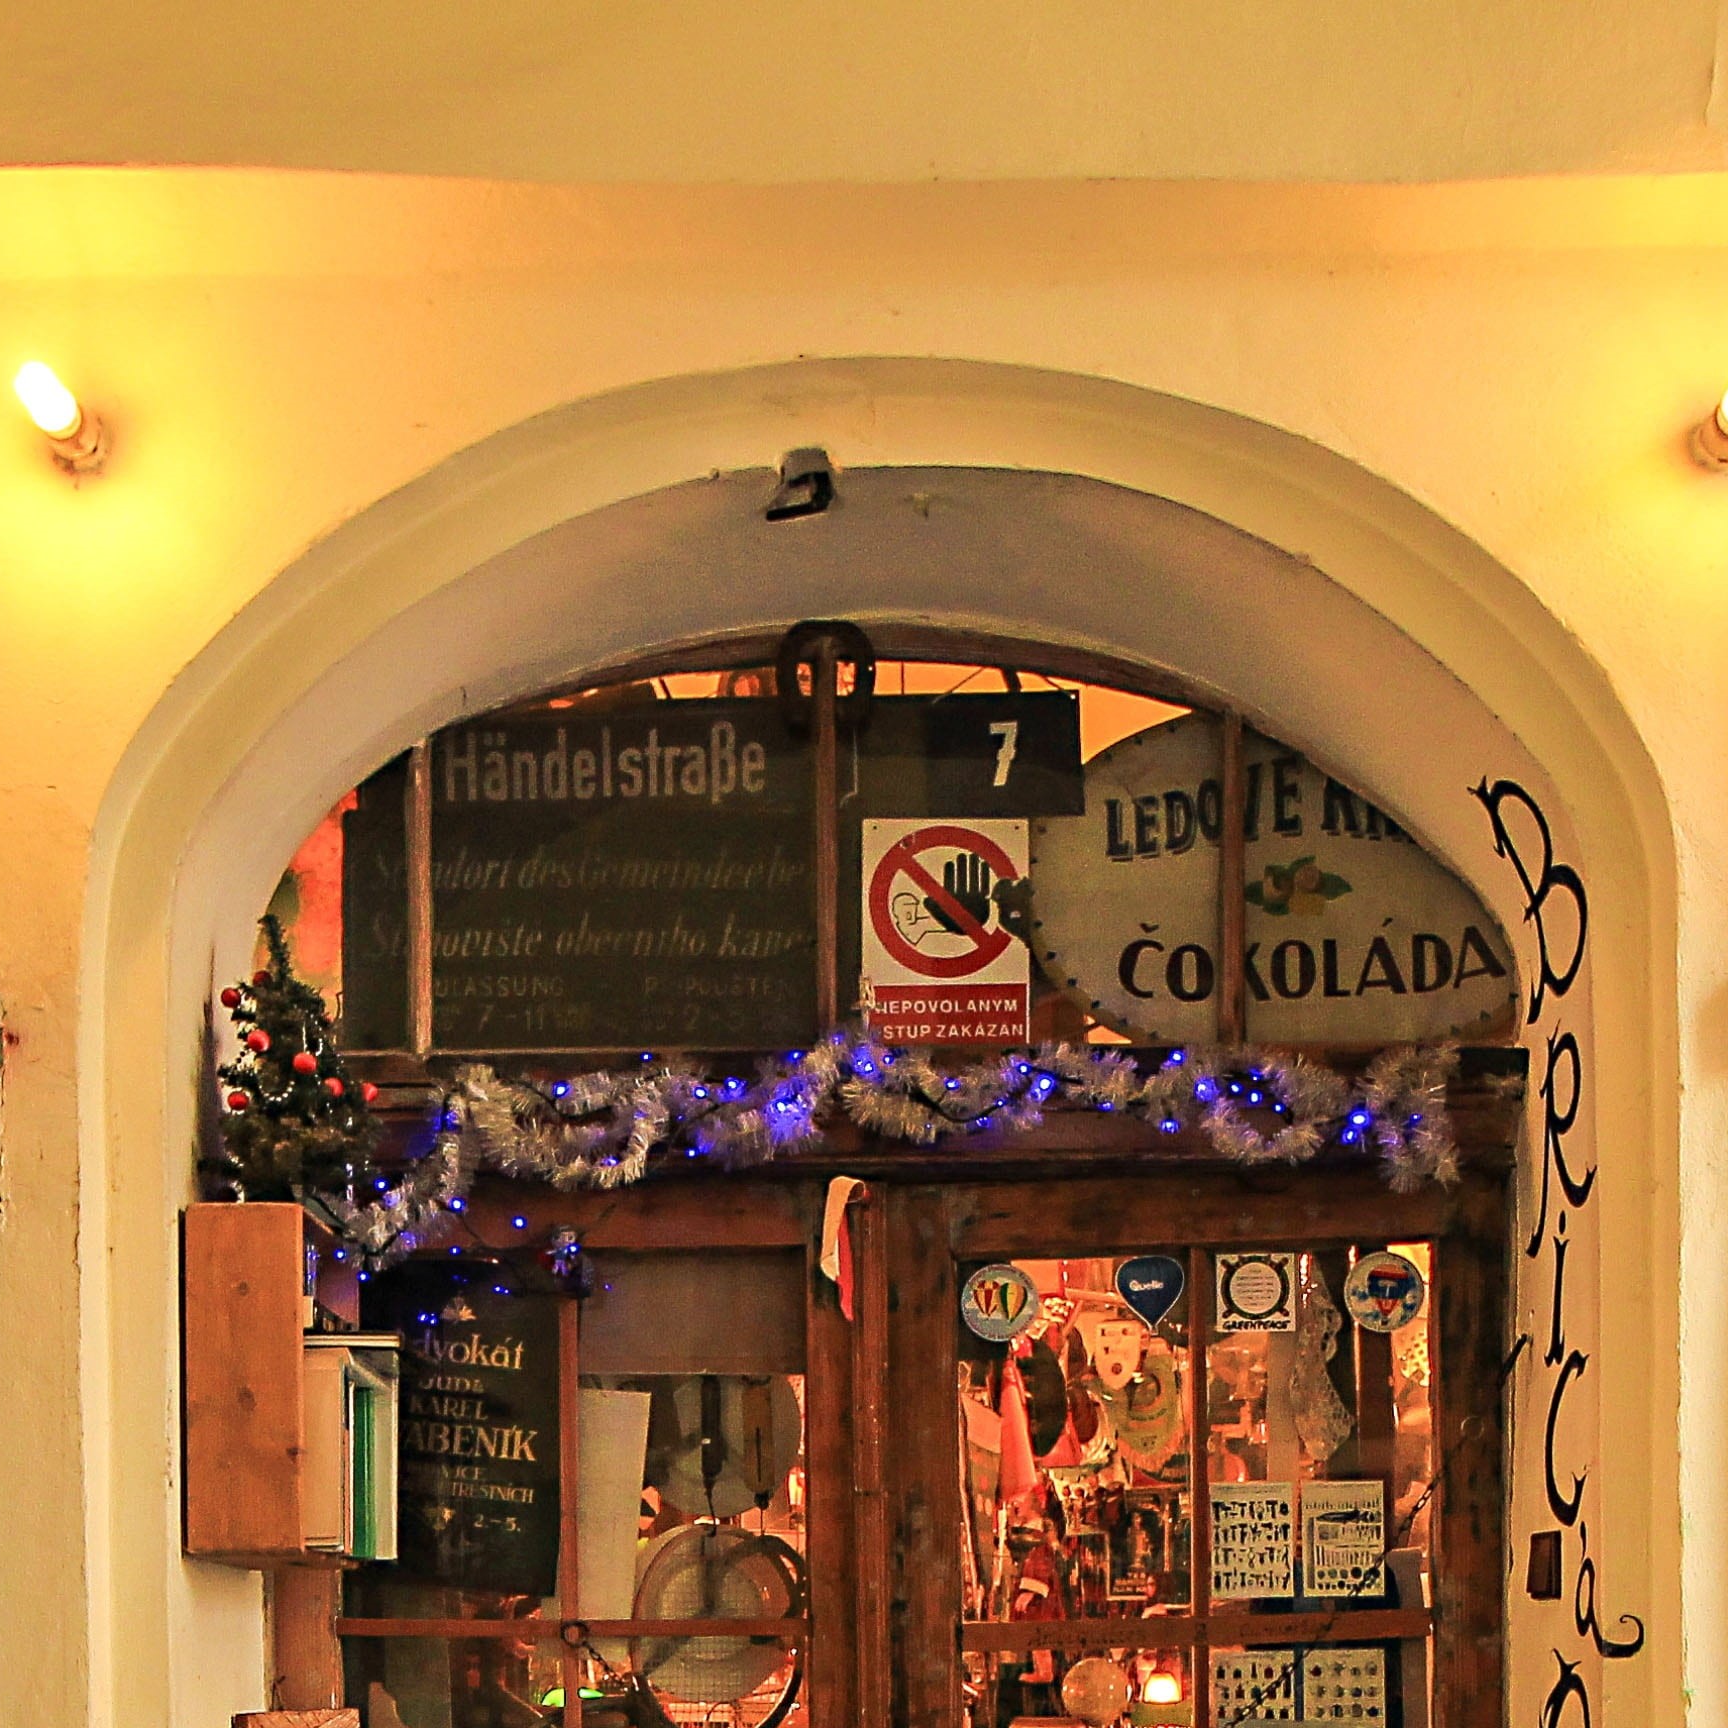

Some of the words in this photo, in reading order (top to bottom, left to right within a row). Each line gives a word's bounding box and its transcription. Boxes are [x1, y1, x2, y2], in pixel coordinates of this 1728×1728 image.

[444, 721, 766, 805] Händelstraße
[988, 720, 1019, 788] 7
[1118, 917, 1507, 1001] ČOKOLÁDA
[883, 1024, 932, 1040] STUP
[1222, 1319, 1291, 1331] GREENPEACE
[413, 1328, 525, 1370] dvokát
[409, 1395, 489, 1421] KAREL
